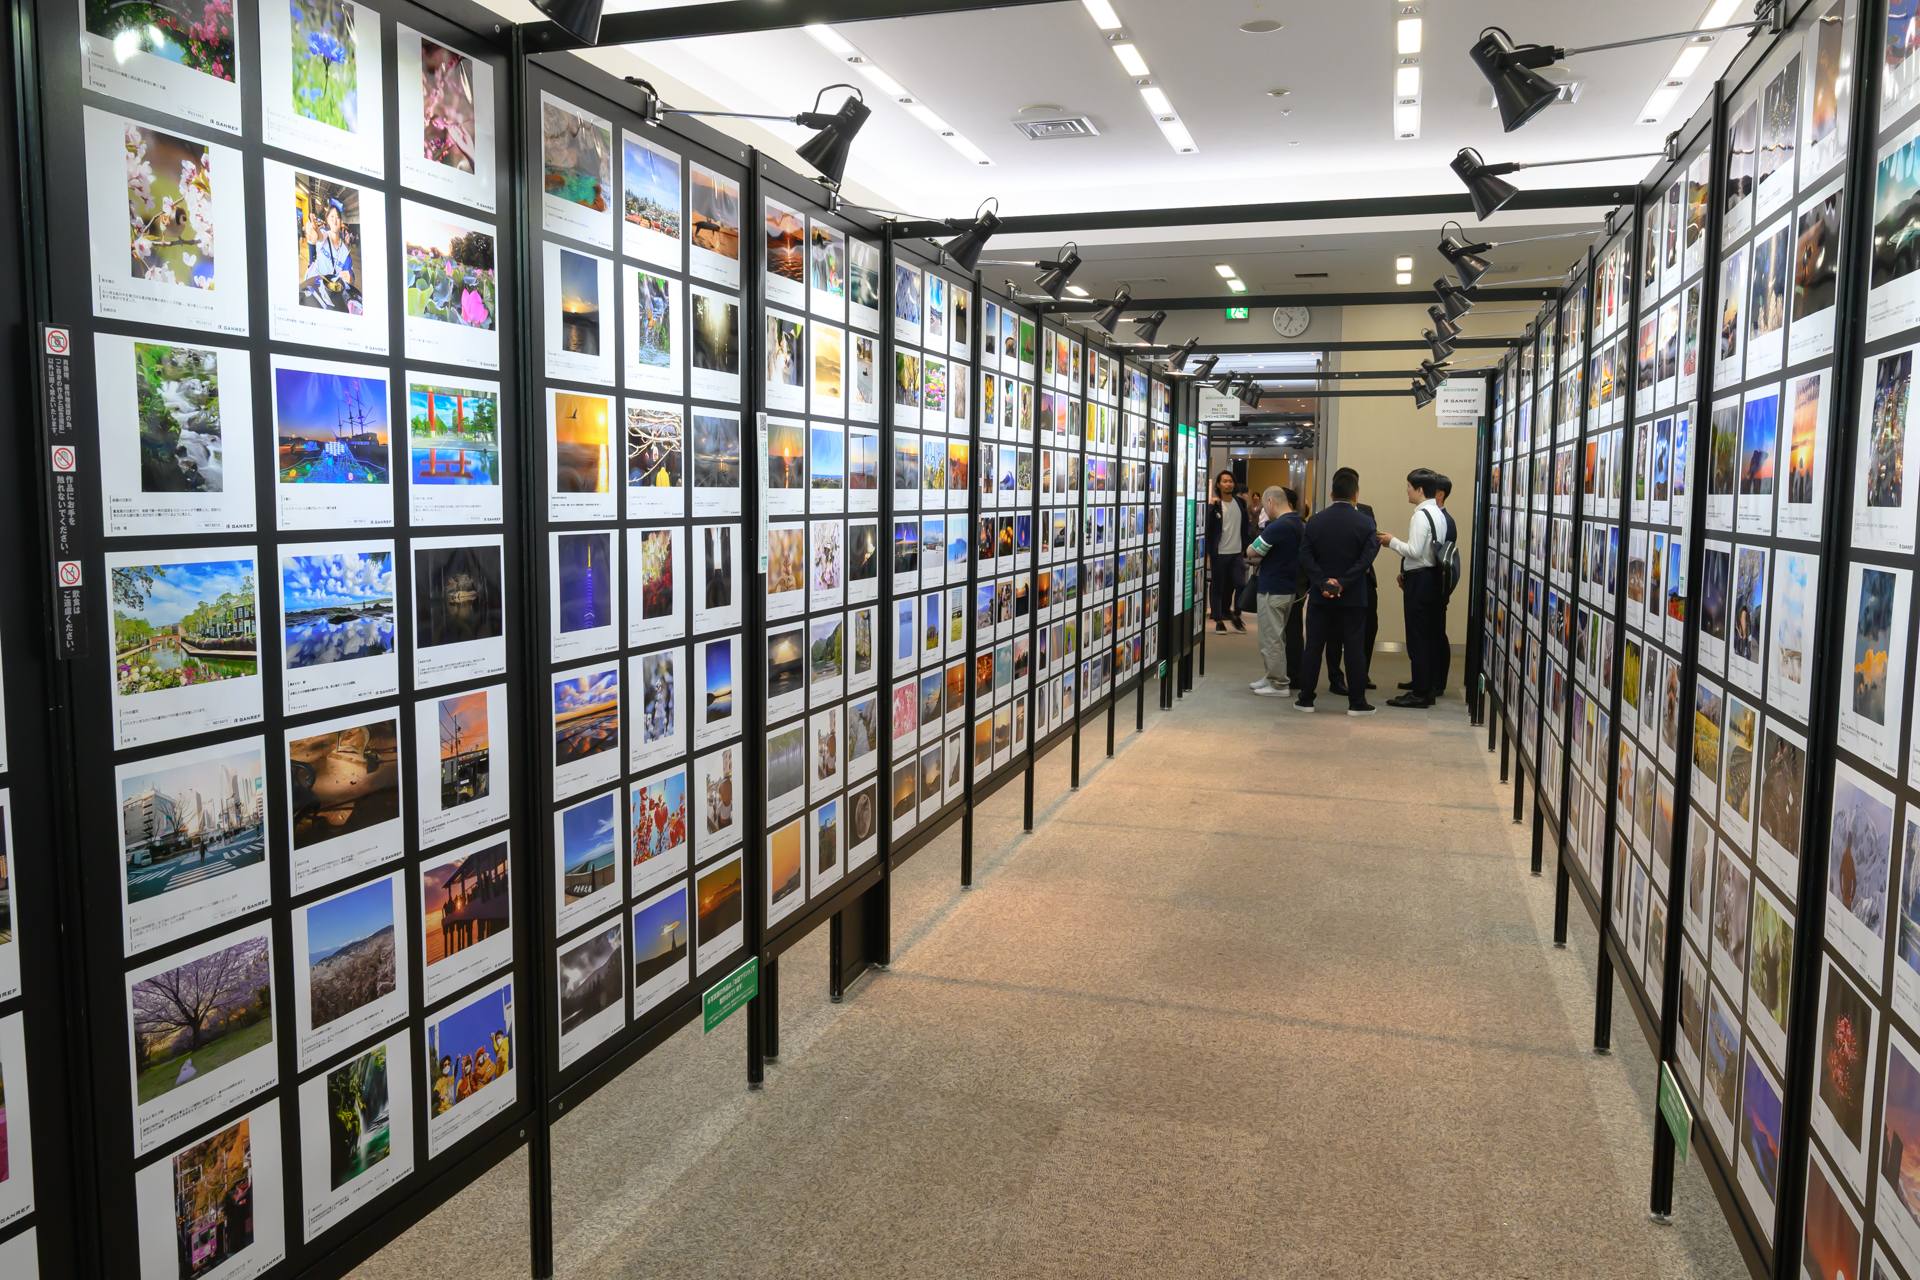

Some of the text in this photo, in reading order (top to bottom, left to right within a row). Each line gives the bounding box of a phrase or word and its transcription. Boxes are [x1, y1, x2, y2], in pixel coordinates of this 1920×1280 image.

[56, 475, 69, 554] 触れないでください。
[66, 475, 76, 526] 作品にお手を
[63, 590, 74, 651] ご遠慮ください。
[72, 589, 81, 615] 飲食は
[0, 1204, 31, 1224] GANREF
